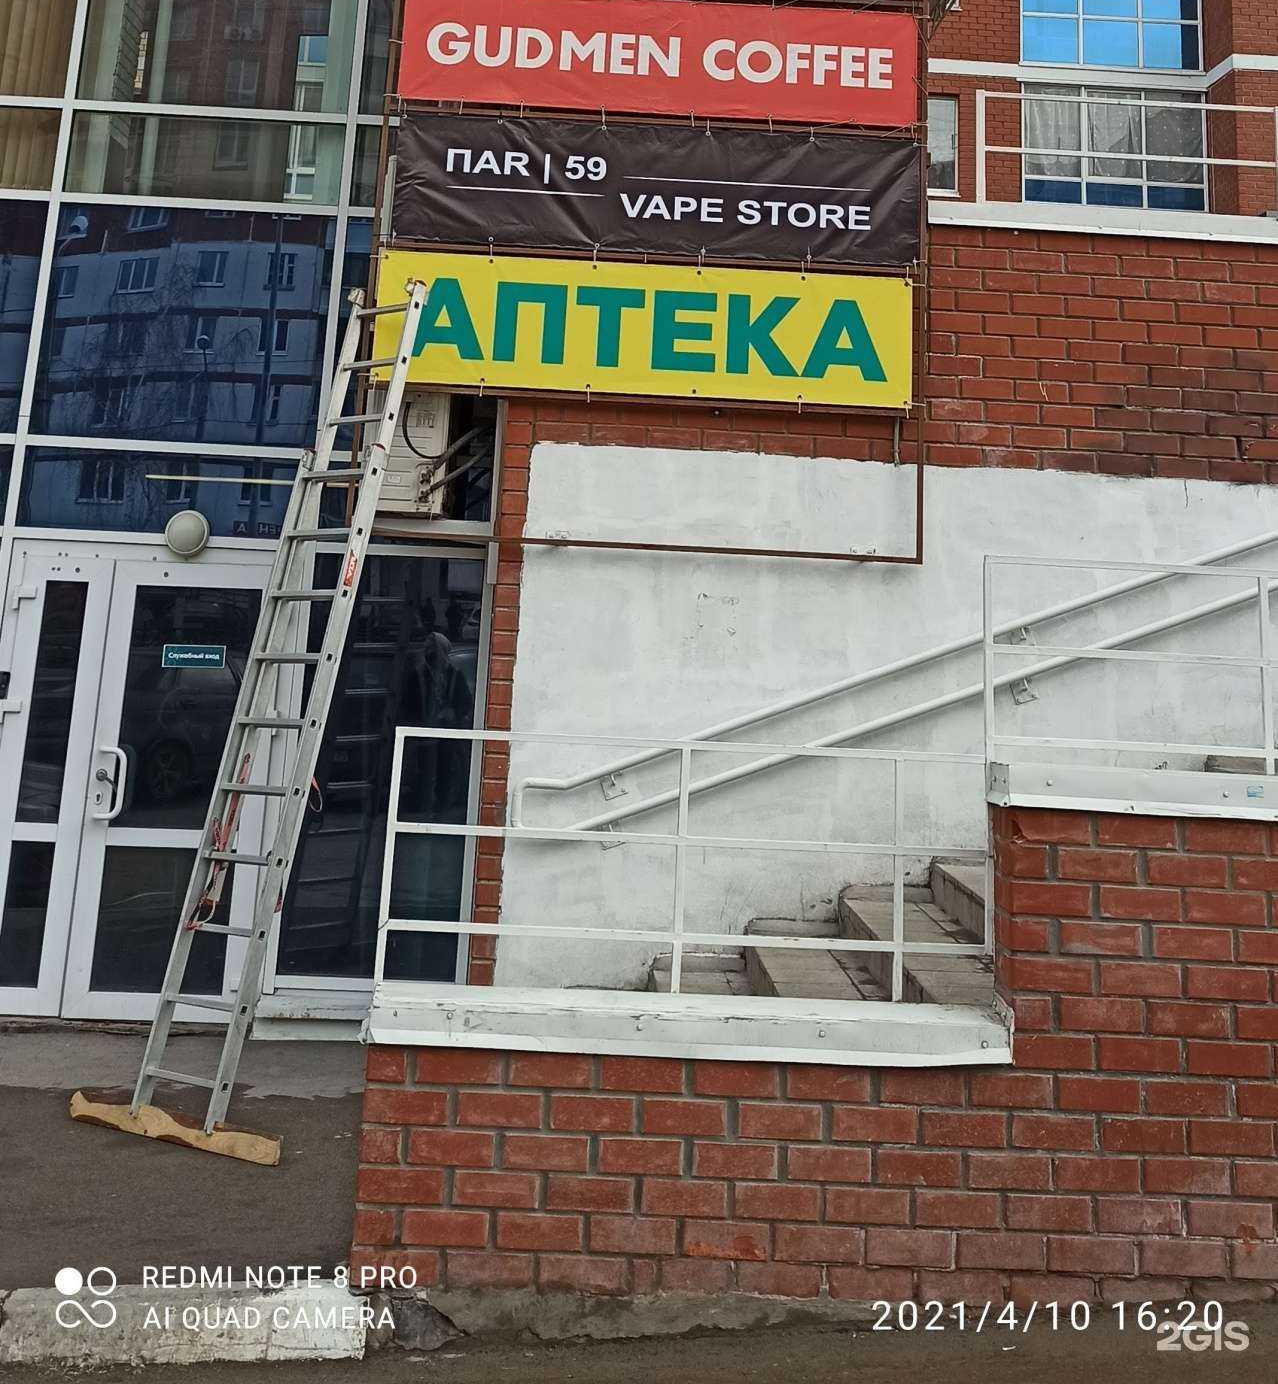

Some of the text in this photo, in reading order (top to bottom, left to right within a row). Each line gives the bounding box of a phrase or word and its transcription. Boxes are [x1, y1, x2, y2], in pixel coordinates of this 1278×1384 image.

[426, 21, 894, 90] GUDMEN COFFEE
[564, 155, 607, 181] 59
[619, 193, 872, 231] VAPE STORE
[412, 277, 888, 383] АПТЕКА
